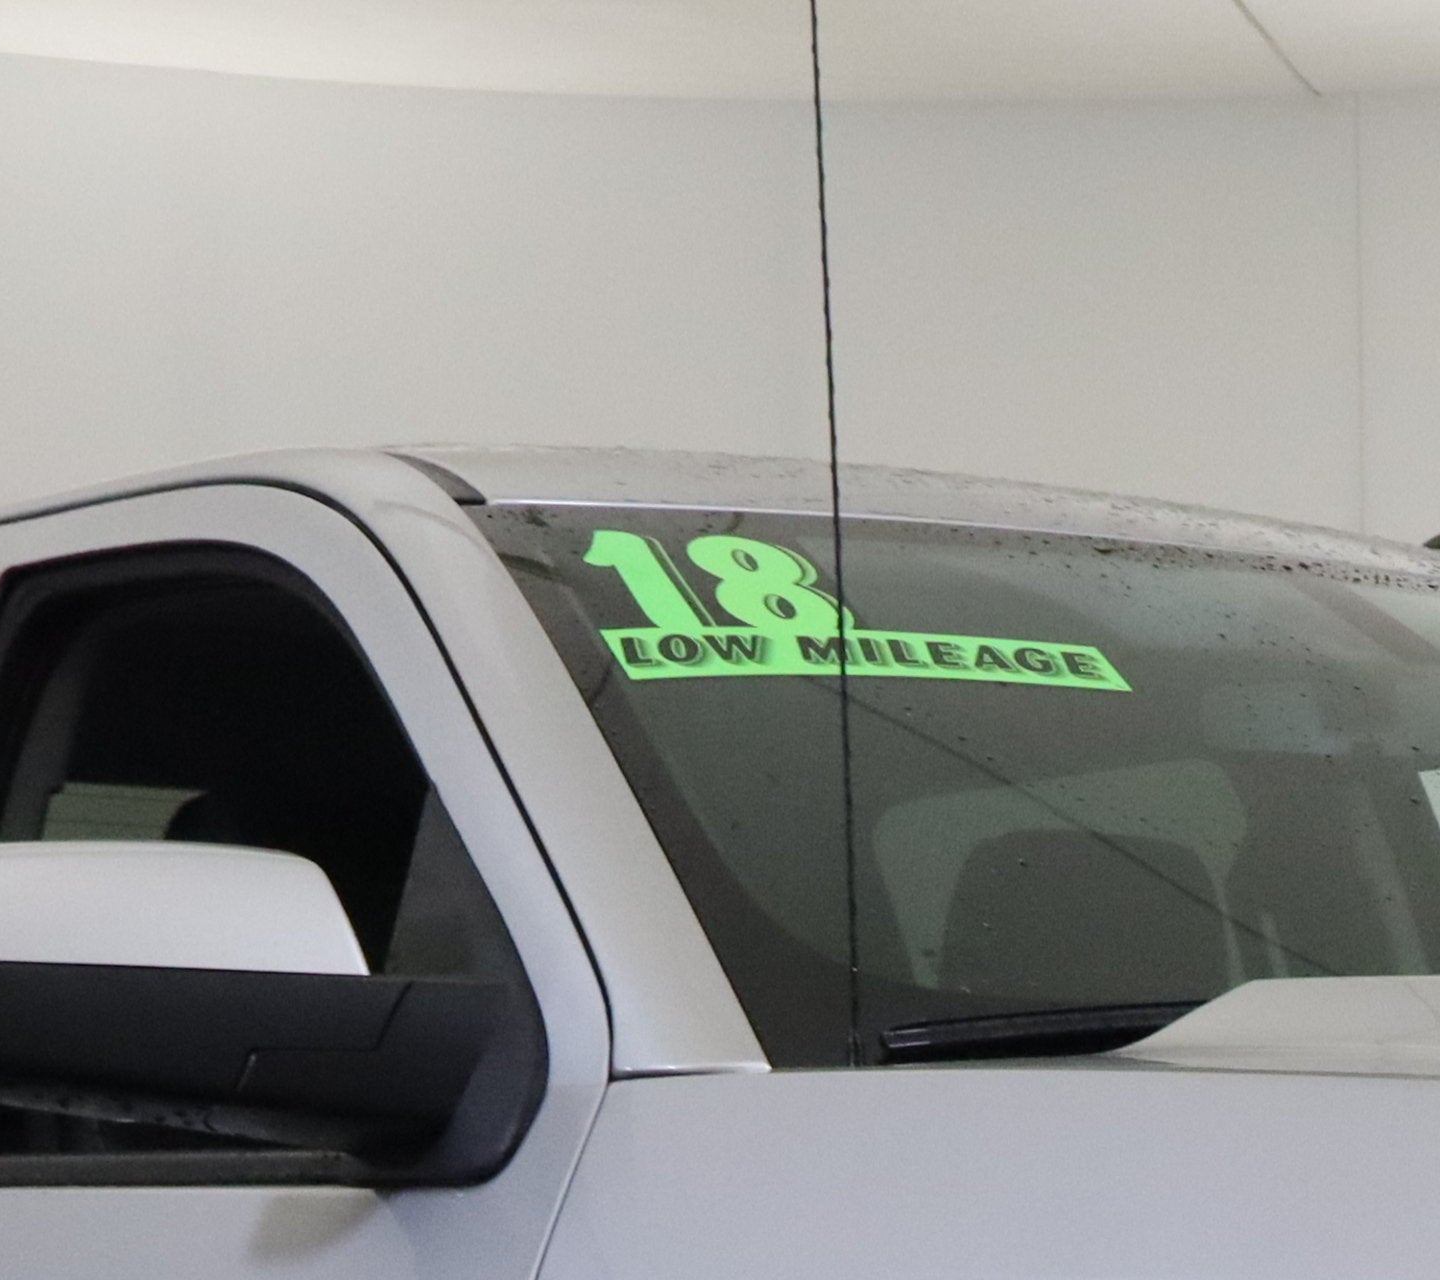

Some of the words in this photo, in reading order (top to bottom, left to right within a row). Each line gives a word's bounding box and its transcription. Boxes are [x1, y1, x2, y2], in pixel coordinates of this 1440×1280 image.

[582, 529, 855, 630] 18
[620, 634, 762, 668] LOW
[796, 634, 1106, 681] MILEAGE
